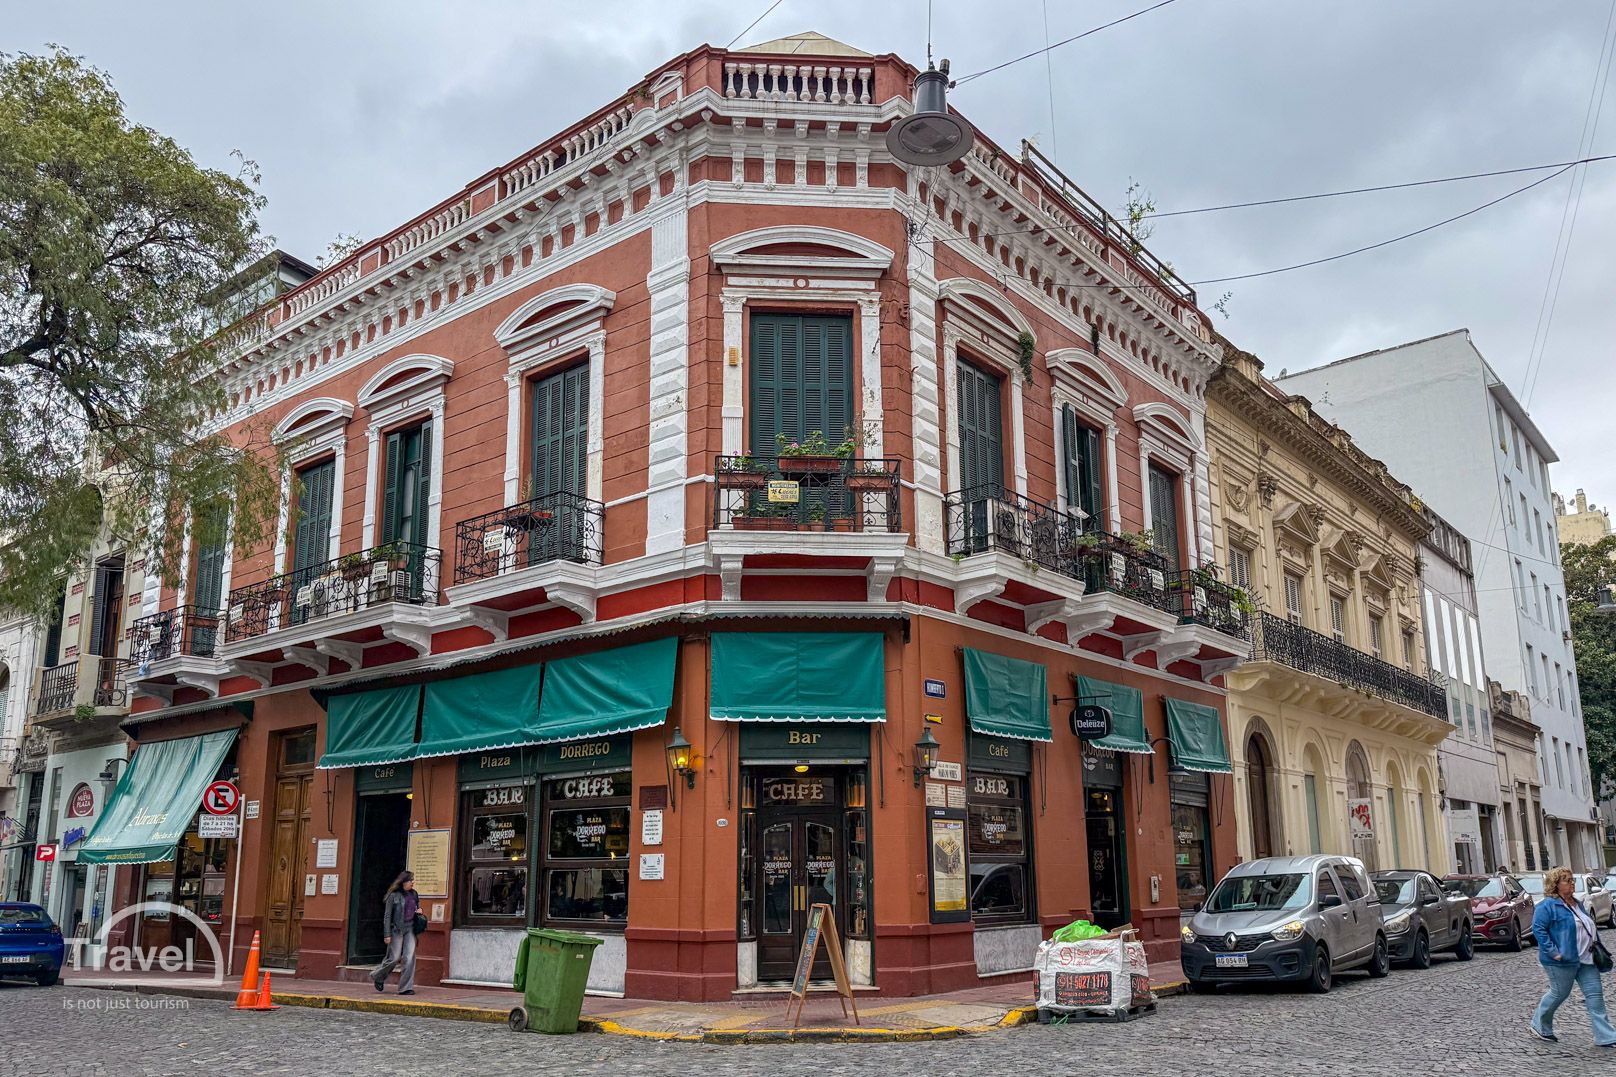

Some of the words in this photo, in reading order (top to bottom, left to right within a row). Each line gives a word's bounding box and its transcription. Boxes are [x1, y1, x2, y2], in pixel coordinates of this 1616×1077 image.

[1076, 719, 1105, 728] Deleuze
[789, 731, 821, 744] Bar
[560, 741, 610, 759] DORREGO
[480, 756, 511, 768] Plaza
[974, 777, 1009, 795] BAR
[483, 787, 524, 806] BAR
[490, 829, 516, 840] DORREGO
[577, 824, 606, 836] DORREGO
[502, 839, 512, 847] BAR
[591, 836, 601, 844] BAR
[763, 861, 792, 870] DORREGO
[806, 861, 835, 870] DORREGO
